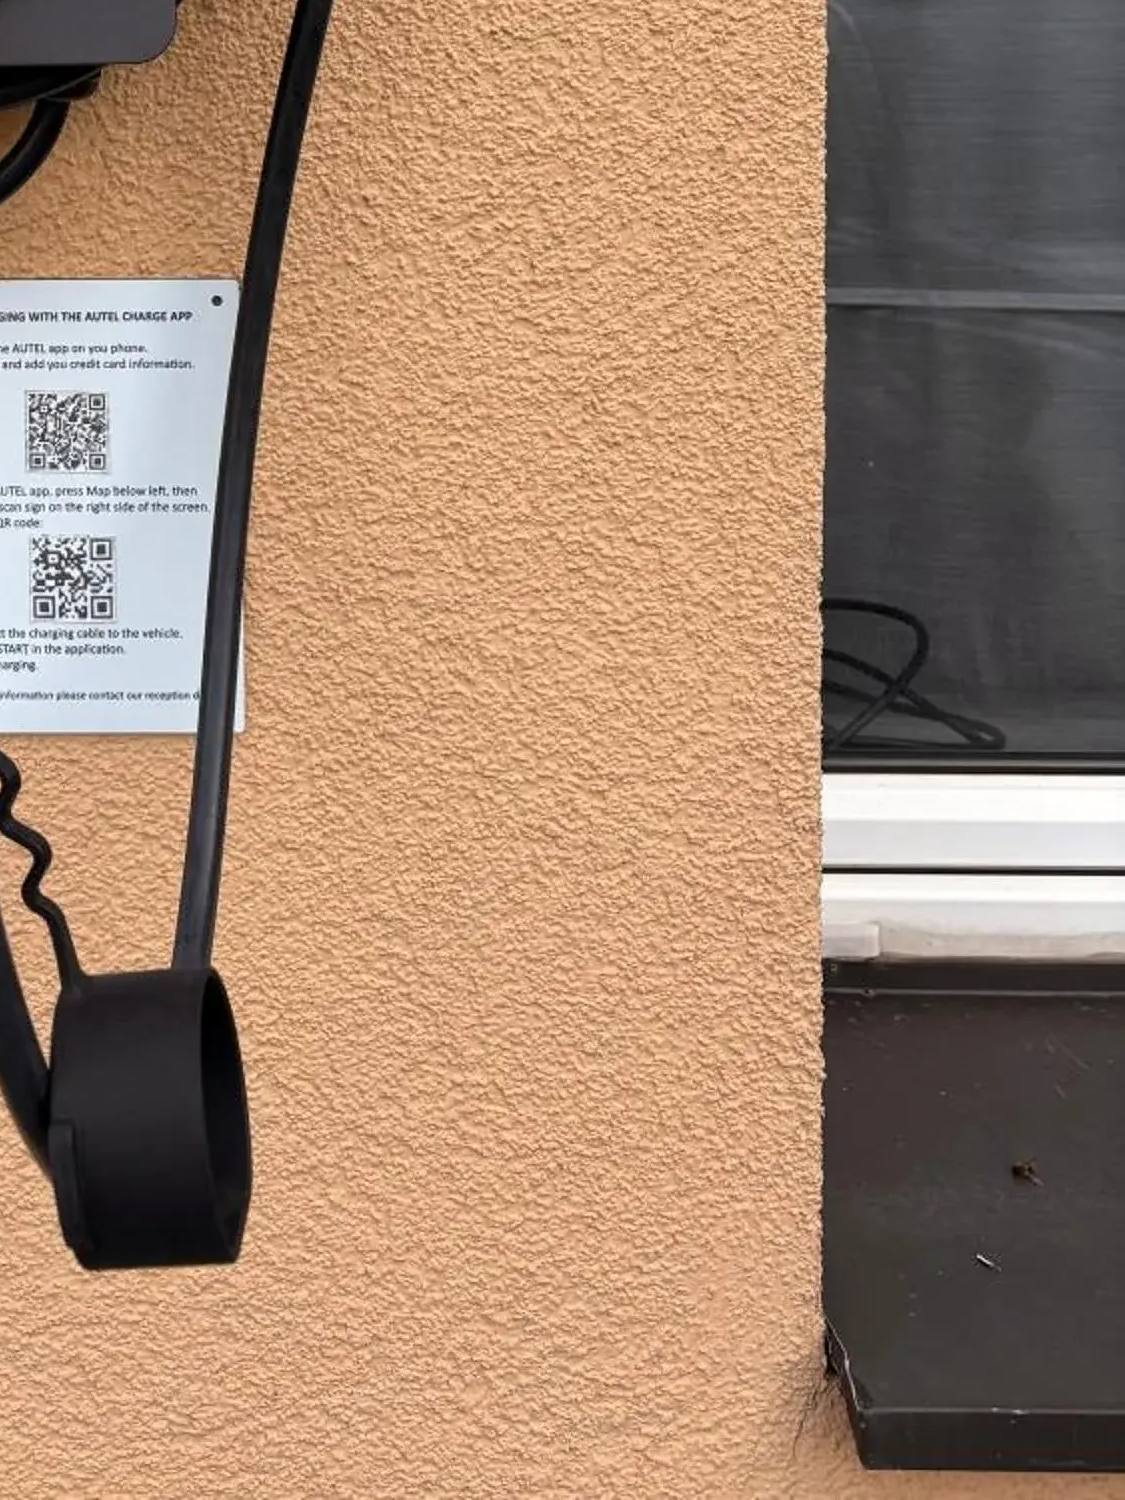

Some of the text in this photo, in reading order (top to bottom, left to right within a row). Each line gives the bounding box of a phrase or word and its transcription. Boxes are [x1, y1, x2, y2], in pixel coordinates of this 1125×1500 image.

[28, 312, 58, 322] WITH
[61, 311, 82, 322] THE
[84, 311, 119, 322] AUTEL
[122, 311, 168, 322] CHARGE
[170, 311, 194, 321] APP
[12, 343, 46, 354] AUTEL
[48, 346, 67, 356] app
[88, 345, 108, 355] you
[110, 343, 148, 354] phone.
[1, 358, 22, 370] and
[24, 359, 45, 369] add
[47, 361, 68, 372] you
[69, 359, 101, 369] credit
[102, 358, 126, 369] card
[128, 358, 196, 369] information.
[55, 488, 84, 498] press
[86, 486, 111, 498] Map
[112, 485, 146, 496] below
[172, 486, 198, 496] then
[24, 502, 46, 514] sign
[64, 502, 84, 512] the
[86, 502, 111, 514] right
[113, 502, 135, 513] side
[151, 501, 170, 512] the
[13, 518, 44, 528] code:
[8, 628, 26, 639] the
[28, 628, 74, 641] charging
[76, 628, 106, 639] cable
[121, 628, 140, 638] the
[43, 644, 60, 655] the
[56, 691, 86, 701] please
[88, 692, 124, 700] contact
[126, 692, 142, 701] our
[144, 692, 192, 701] reception
